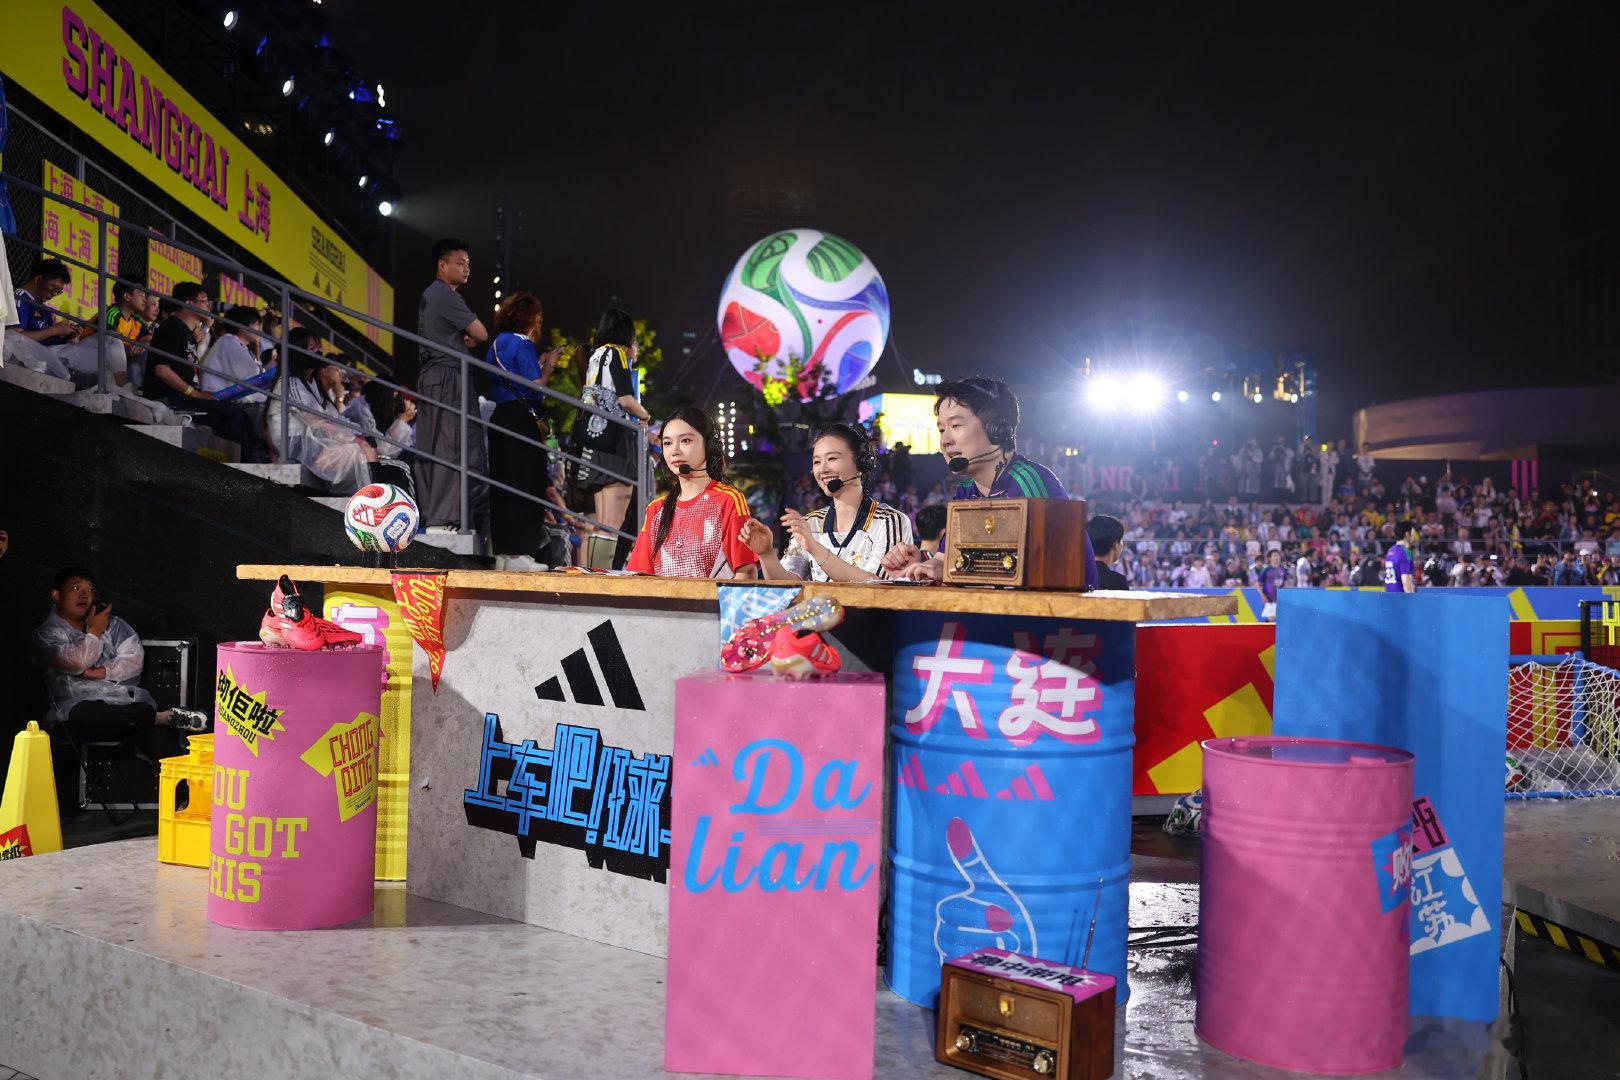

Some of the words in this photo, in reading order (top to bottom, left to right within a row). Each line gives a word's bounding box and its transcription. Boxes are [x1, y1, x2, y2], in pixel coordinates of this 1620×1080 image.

[62, 6, 229, 211] SHANGHAI
[238, 168, 271, 243] 上海
[64, 221, 92, 264] 上海
[311, 225, 346, 275] SHANGHAI
[905, 622, 1103, 745] 大连
[328, 719, 375, 768] CHONG
[213, 764, 251, 811] OU
[341, 752, 374, 799] QING
[729, 738, 872, 817] Da
[225, 812, 308, 858] GOT
[684, 815, 874, 894] lian
[209, 853, 262, 904] HIS
